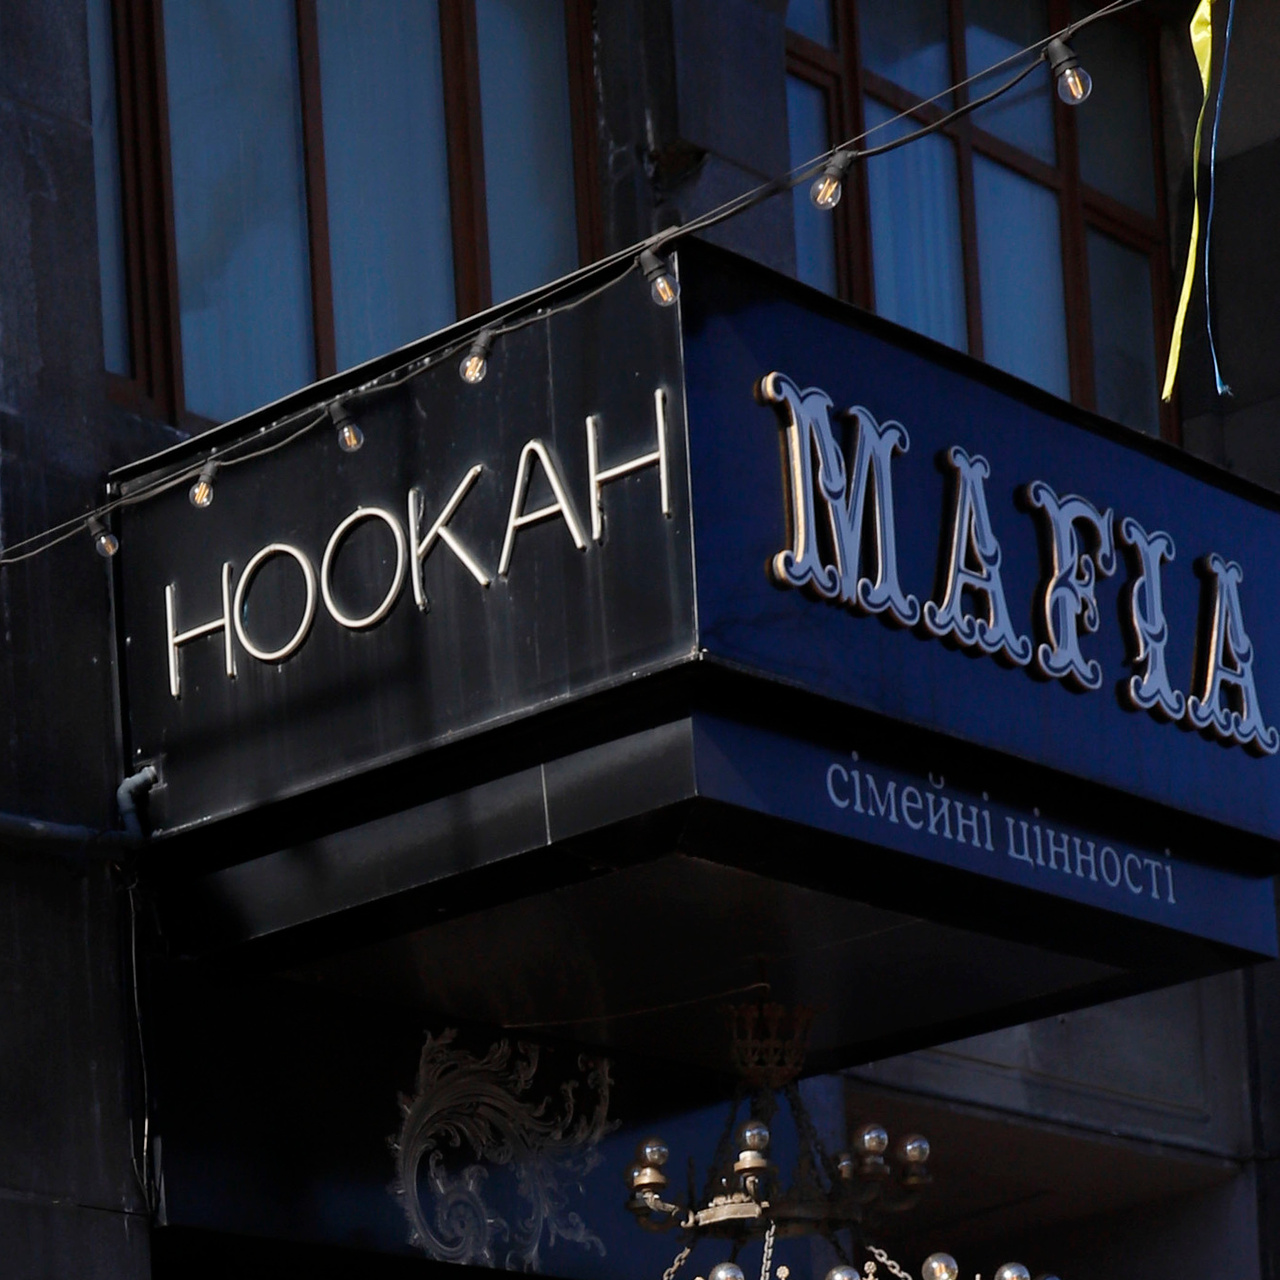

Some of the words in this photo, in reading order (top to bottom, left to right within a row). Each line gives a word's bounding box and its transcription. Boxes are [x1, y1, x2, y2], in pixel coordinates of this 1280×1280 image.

[164, 387, 672, 698] HOOKAH
[758, 370, 1280, 756] MAFIA
[826, 751, 994, 852] сімейні
[1006, 807, 1177, 905] цінності
